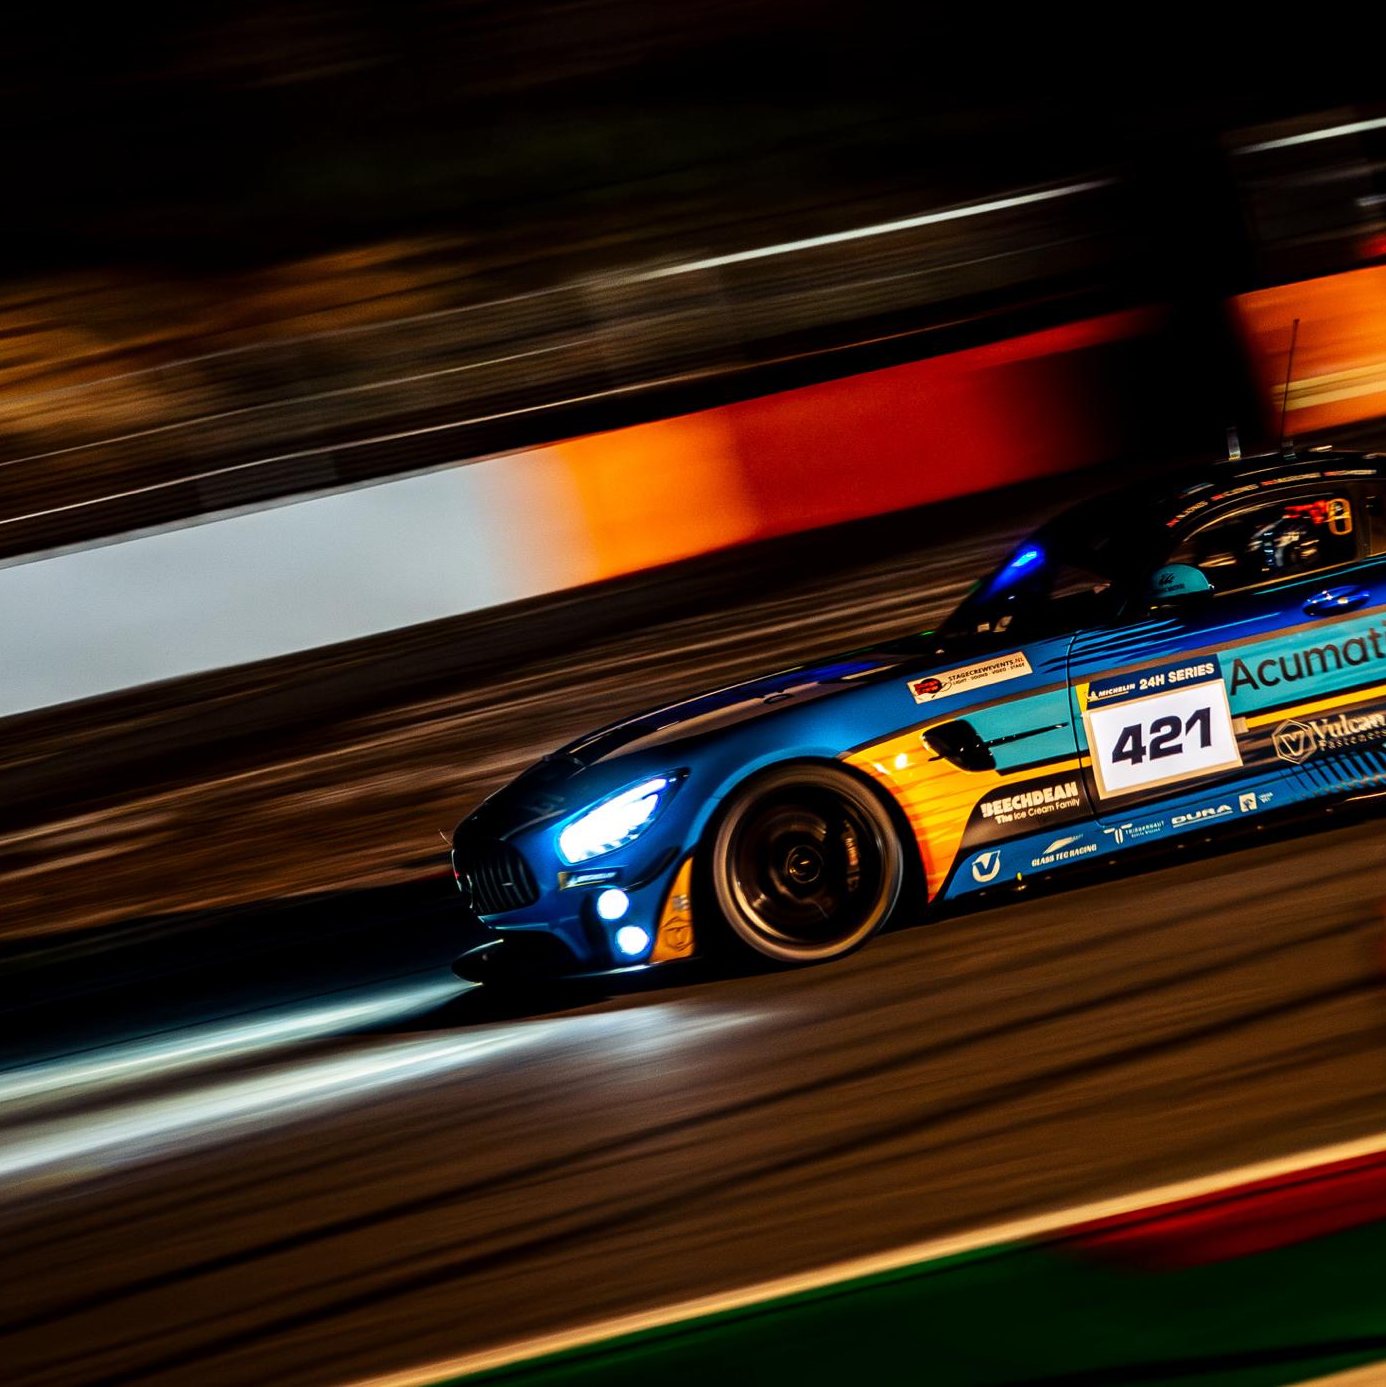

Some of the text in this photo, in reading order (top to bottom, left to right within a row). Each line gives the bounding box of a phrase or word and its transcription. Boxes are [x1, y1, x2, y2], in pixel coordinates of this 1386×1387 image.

[1098, 663, 1215, 697] MICHELIN 24H SERIES
[1112, 706, 1212, 766] 421
[1310, 713, 1386, 740] Vulcan
[980, 781, 1079, 818] BEECHDEAN
[994, 798, 1080, 825] The Ice Cream Family
[1171, 804, 1232, 825] DURA
[1069, 843, 1097, 858] RACING
